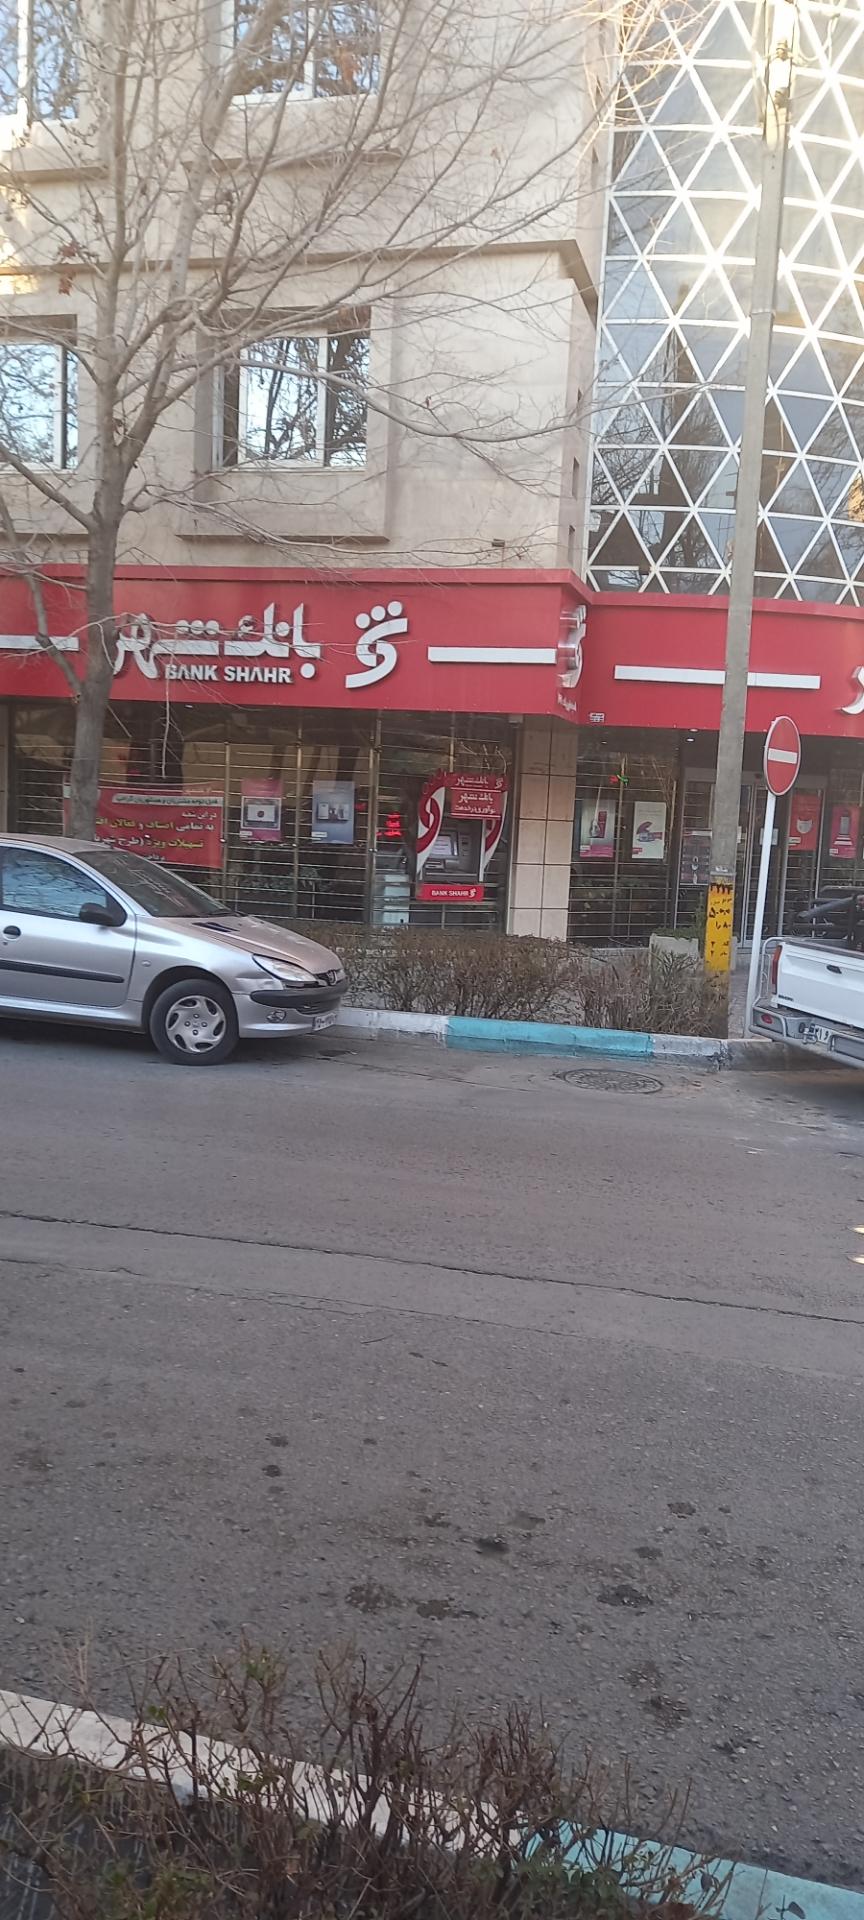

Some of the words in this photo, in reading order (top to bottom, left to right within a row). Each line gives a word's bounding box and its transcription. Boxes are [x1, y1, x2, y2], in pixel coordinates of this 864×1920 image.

[113, 613, 220, 679] شهر
[224, 602, 321, 679] بانک
[165, 664, 219, 682] BANK
[224, 665, 293, 684] SHAHR
